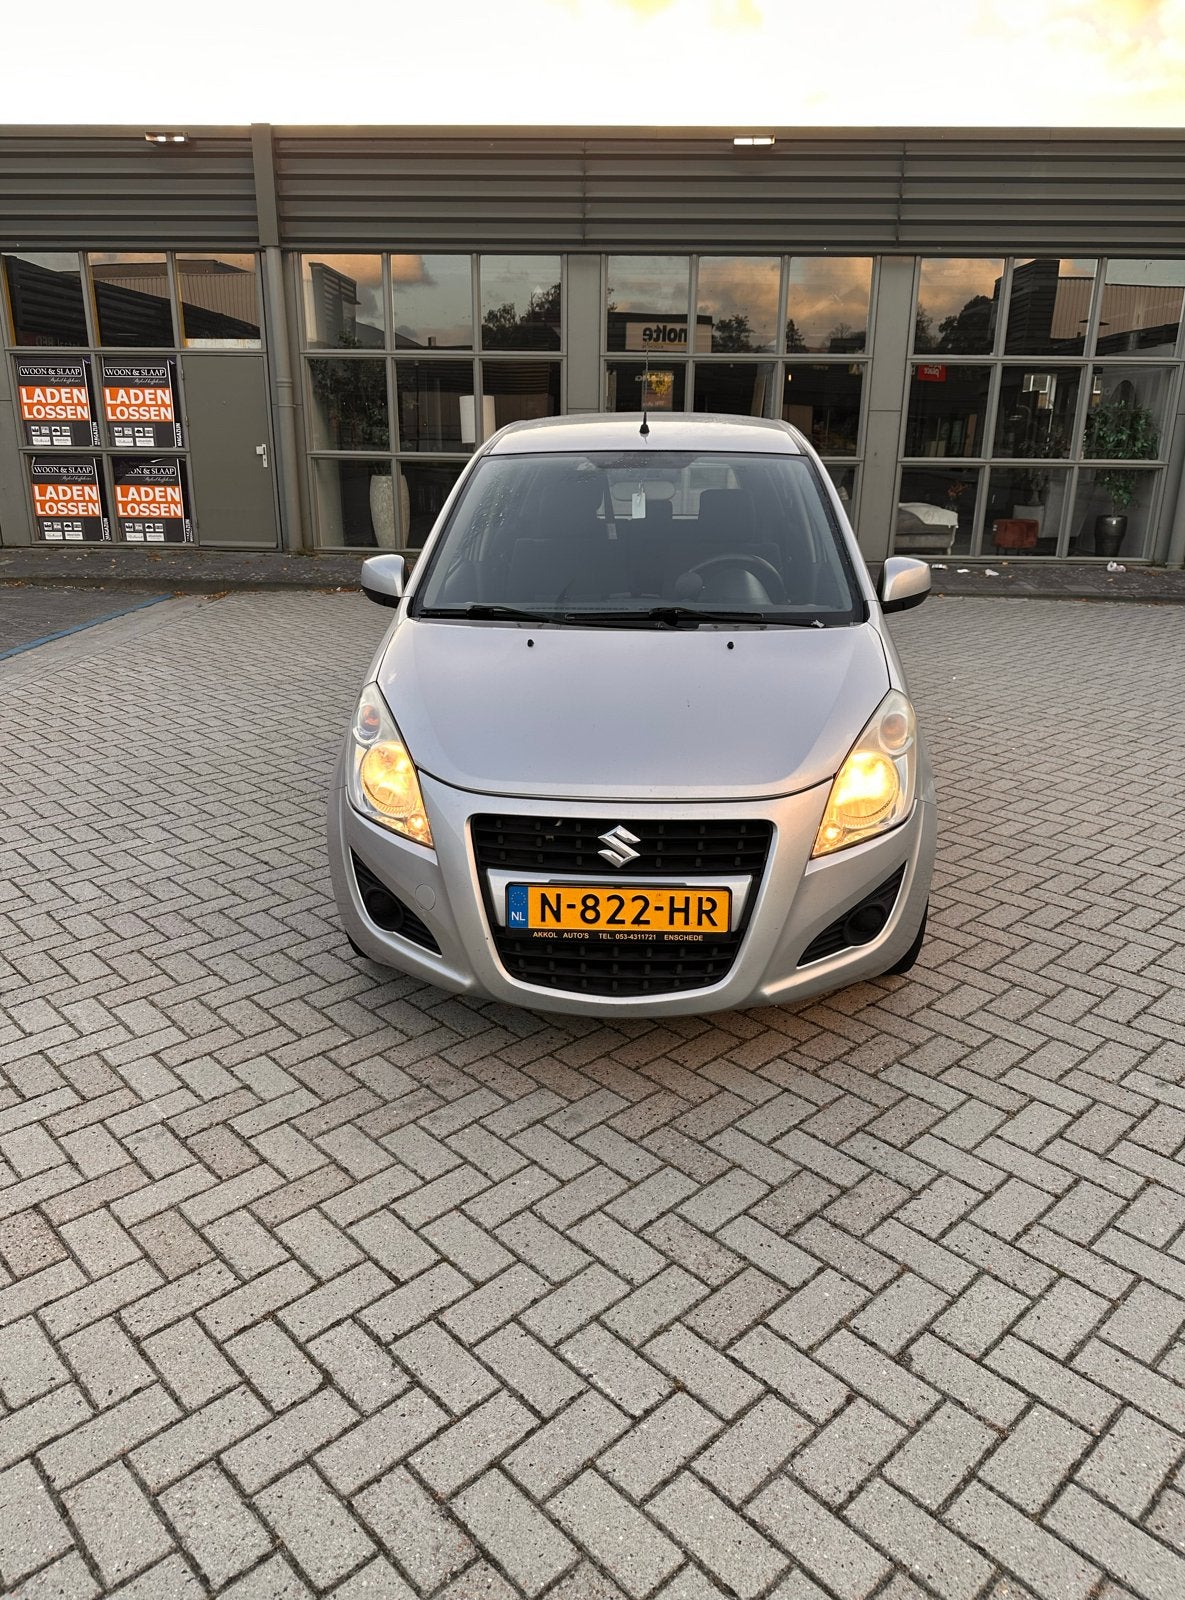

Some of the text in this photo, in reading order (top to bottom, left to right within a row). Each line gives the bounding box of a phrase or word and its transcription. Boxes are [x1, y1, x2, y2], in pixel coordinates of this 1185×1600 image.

[56, 367, 80, 375] SLAAP
[21, 388, 87, 404] LADEN
[105, 389, 171, 405] LADEN
[23, 405, 89, 419] LOSSEN
[107, 406, 172, 420] LOSSEN
[68, 466, 91, 474] SLAAP
[33, 485, 98, 501] LADEN
[116, 486, 180, 502] LADEN
[36, 501, 100, 515] LOSSEN
[118, 502, 182, 516] LOSSEN
[511, 911, 526, 921] NL
[540, 893, 718, 926] N-822-HR
